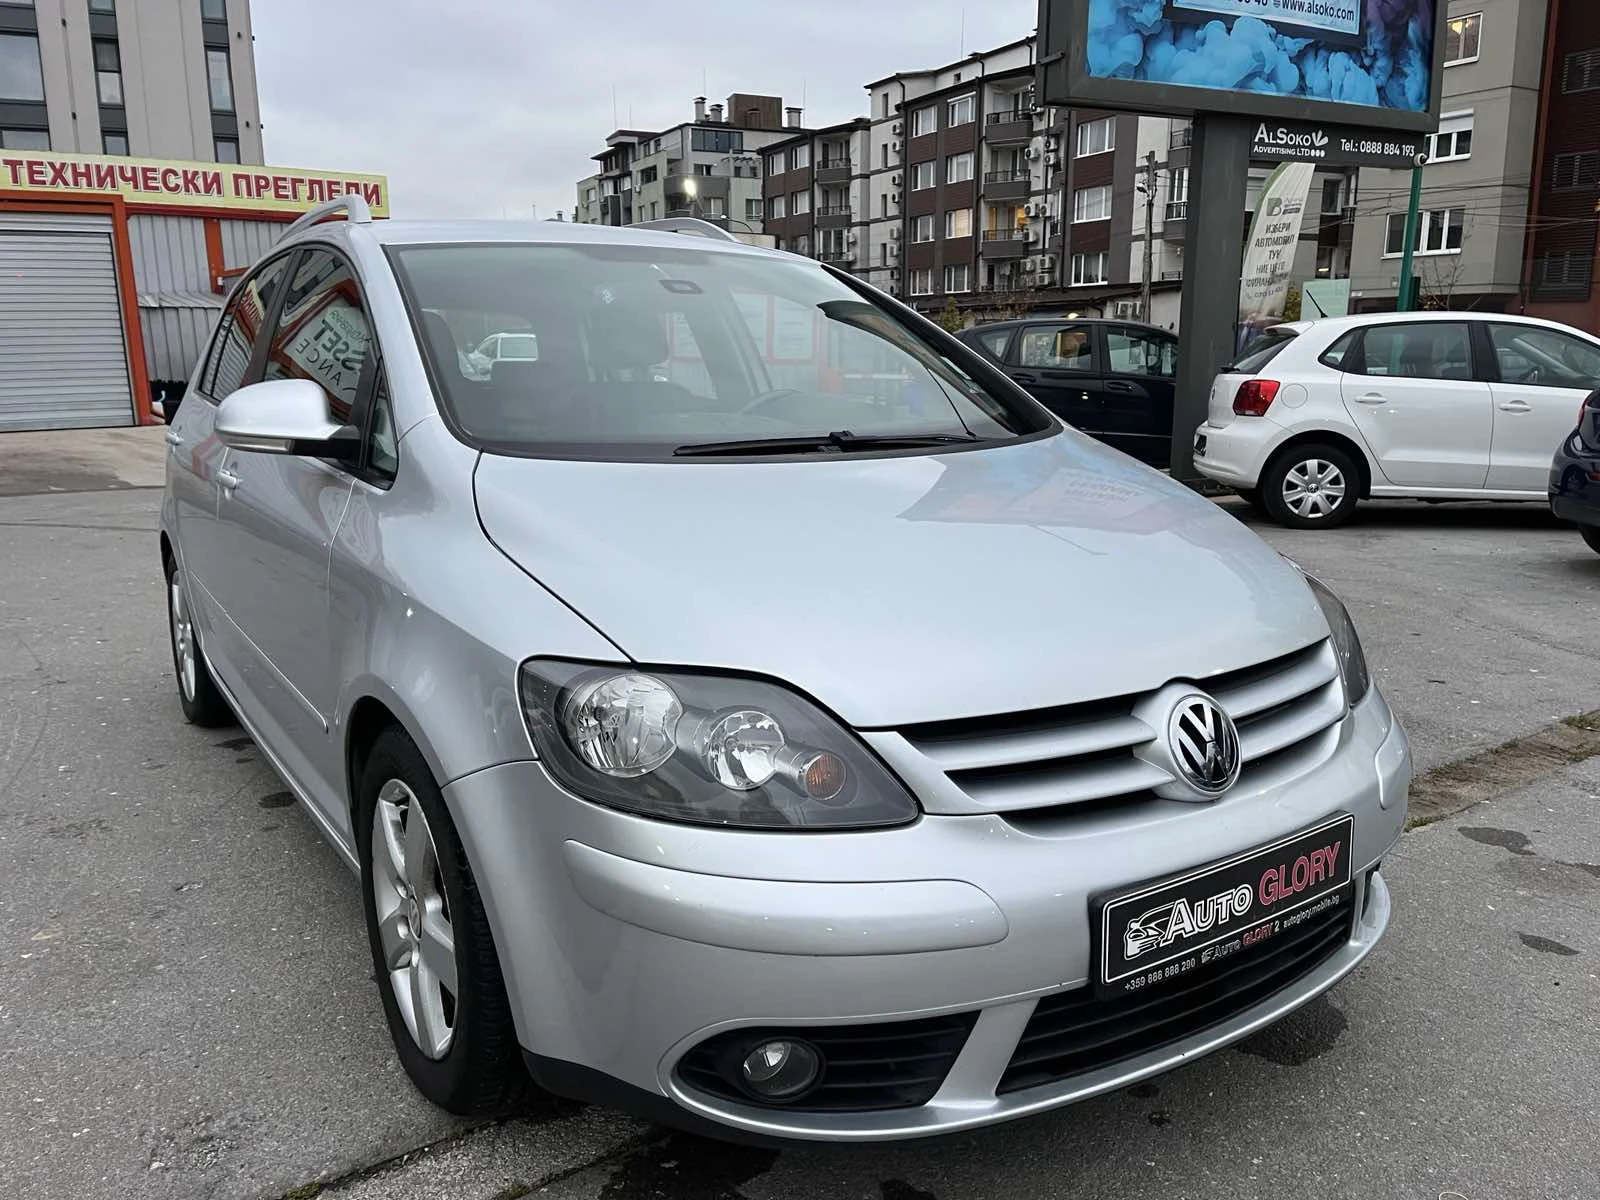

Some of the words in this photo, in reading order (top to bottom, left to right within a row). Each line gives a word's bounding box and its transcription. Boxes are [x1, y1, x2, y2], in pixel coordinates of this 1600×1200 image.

[1297, 148, 1311, 157] LTD
[1360, 140, 1382, 154] 0888
[1384, 142, 1400, 155] 884
[1402, 144, 1415, 157] 193
[2, 158, 225, 197] ТЕХНИЧЕСКИ
[1265, 222, 1292, 235] ИЗБЕРИ
[1259, 841, 1341, 906] GLORY
[1124, 975, 1146, 991] +359
